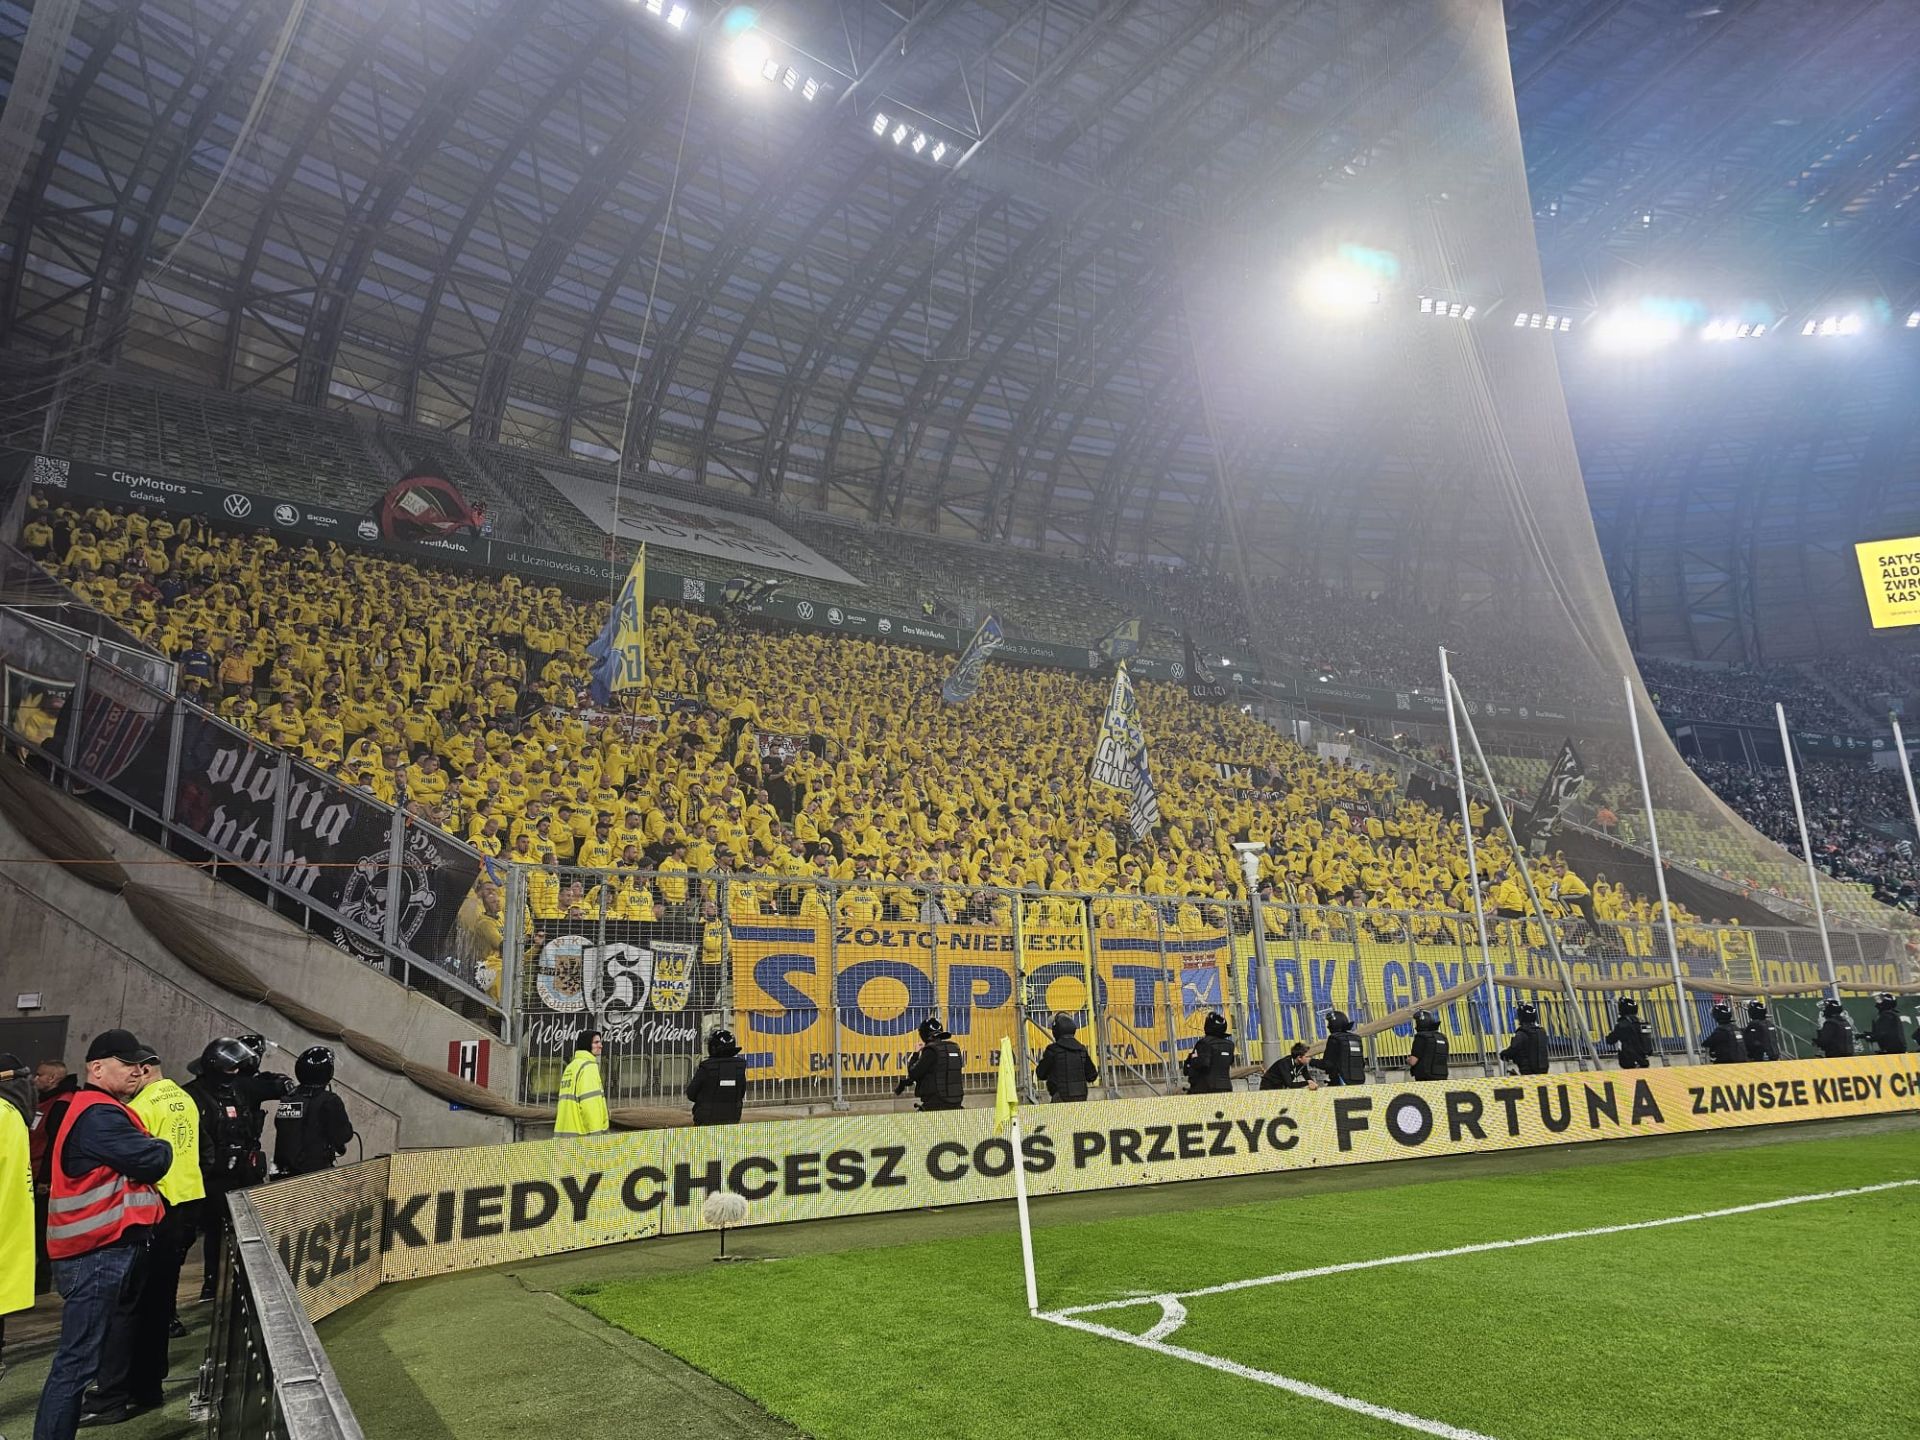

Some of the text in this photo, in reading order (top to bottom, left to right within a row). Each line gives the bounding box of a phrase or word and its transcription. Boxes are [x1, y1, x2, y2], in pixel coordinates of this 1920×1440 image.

[112, 471, 187, 494] CityMotors
[522, 554, 580, 573] Uczniowska
[583, 565, 598, 578] 36,
[1879, 553, 1920, 567] SATYS
[1883, 566, 1920, 579] ALBO
[1884, 578, 1920, 591] ZWR
[652, 979, 685, 990] ARKA
[749, 953, 1174, 1037] SOPOT
[640, 1018, 698, 1044] Wiara
[461, 1046, 477, 1081] H
[1689, 1071, 1920, 1115] ZAWSZE KIEDY CH
[1333, 1079, 1665, 1152] FORTUNA
[382, 1172, 604, 1252] KIEDY
[620, 1146, 907, 1212] CHCESZ
[926, 1126, 1056, 1182] COŚ
[1073, 1108, 1300, 1169] PRZEŻYĆ
